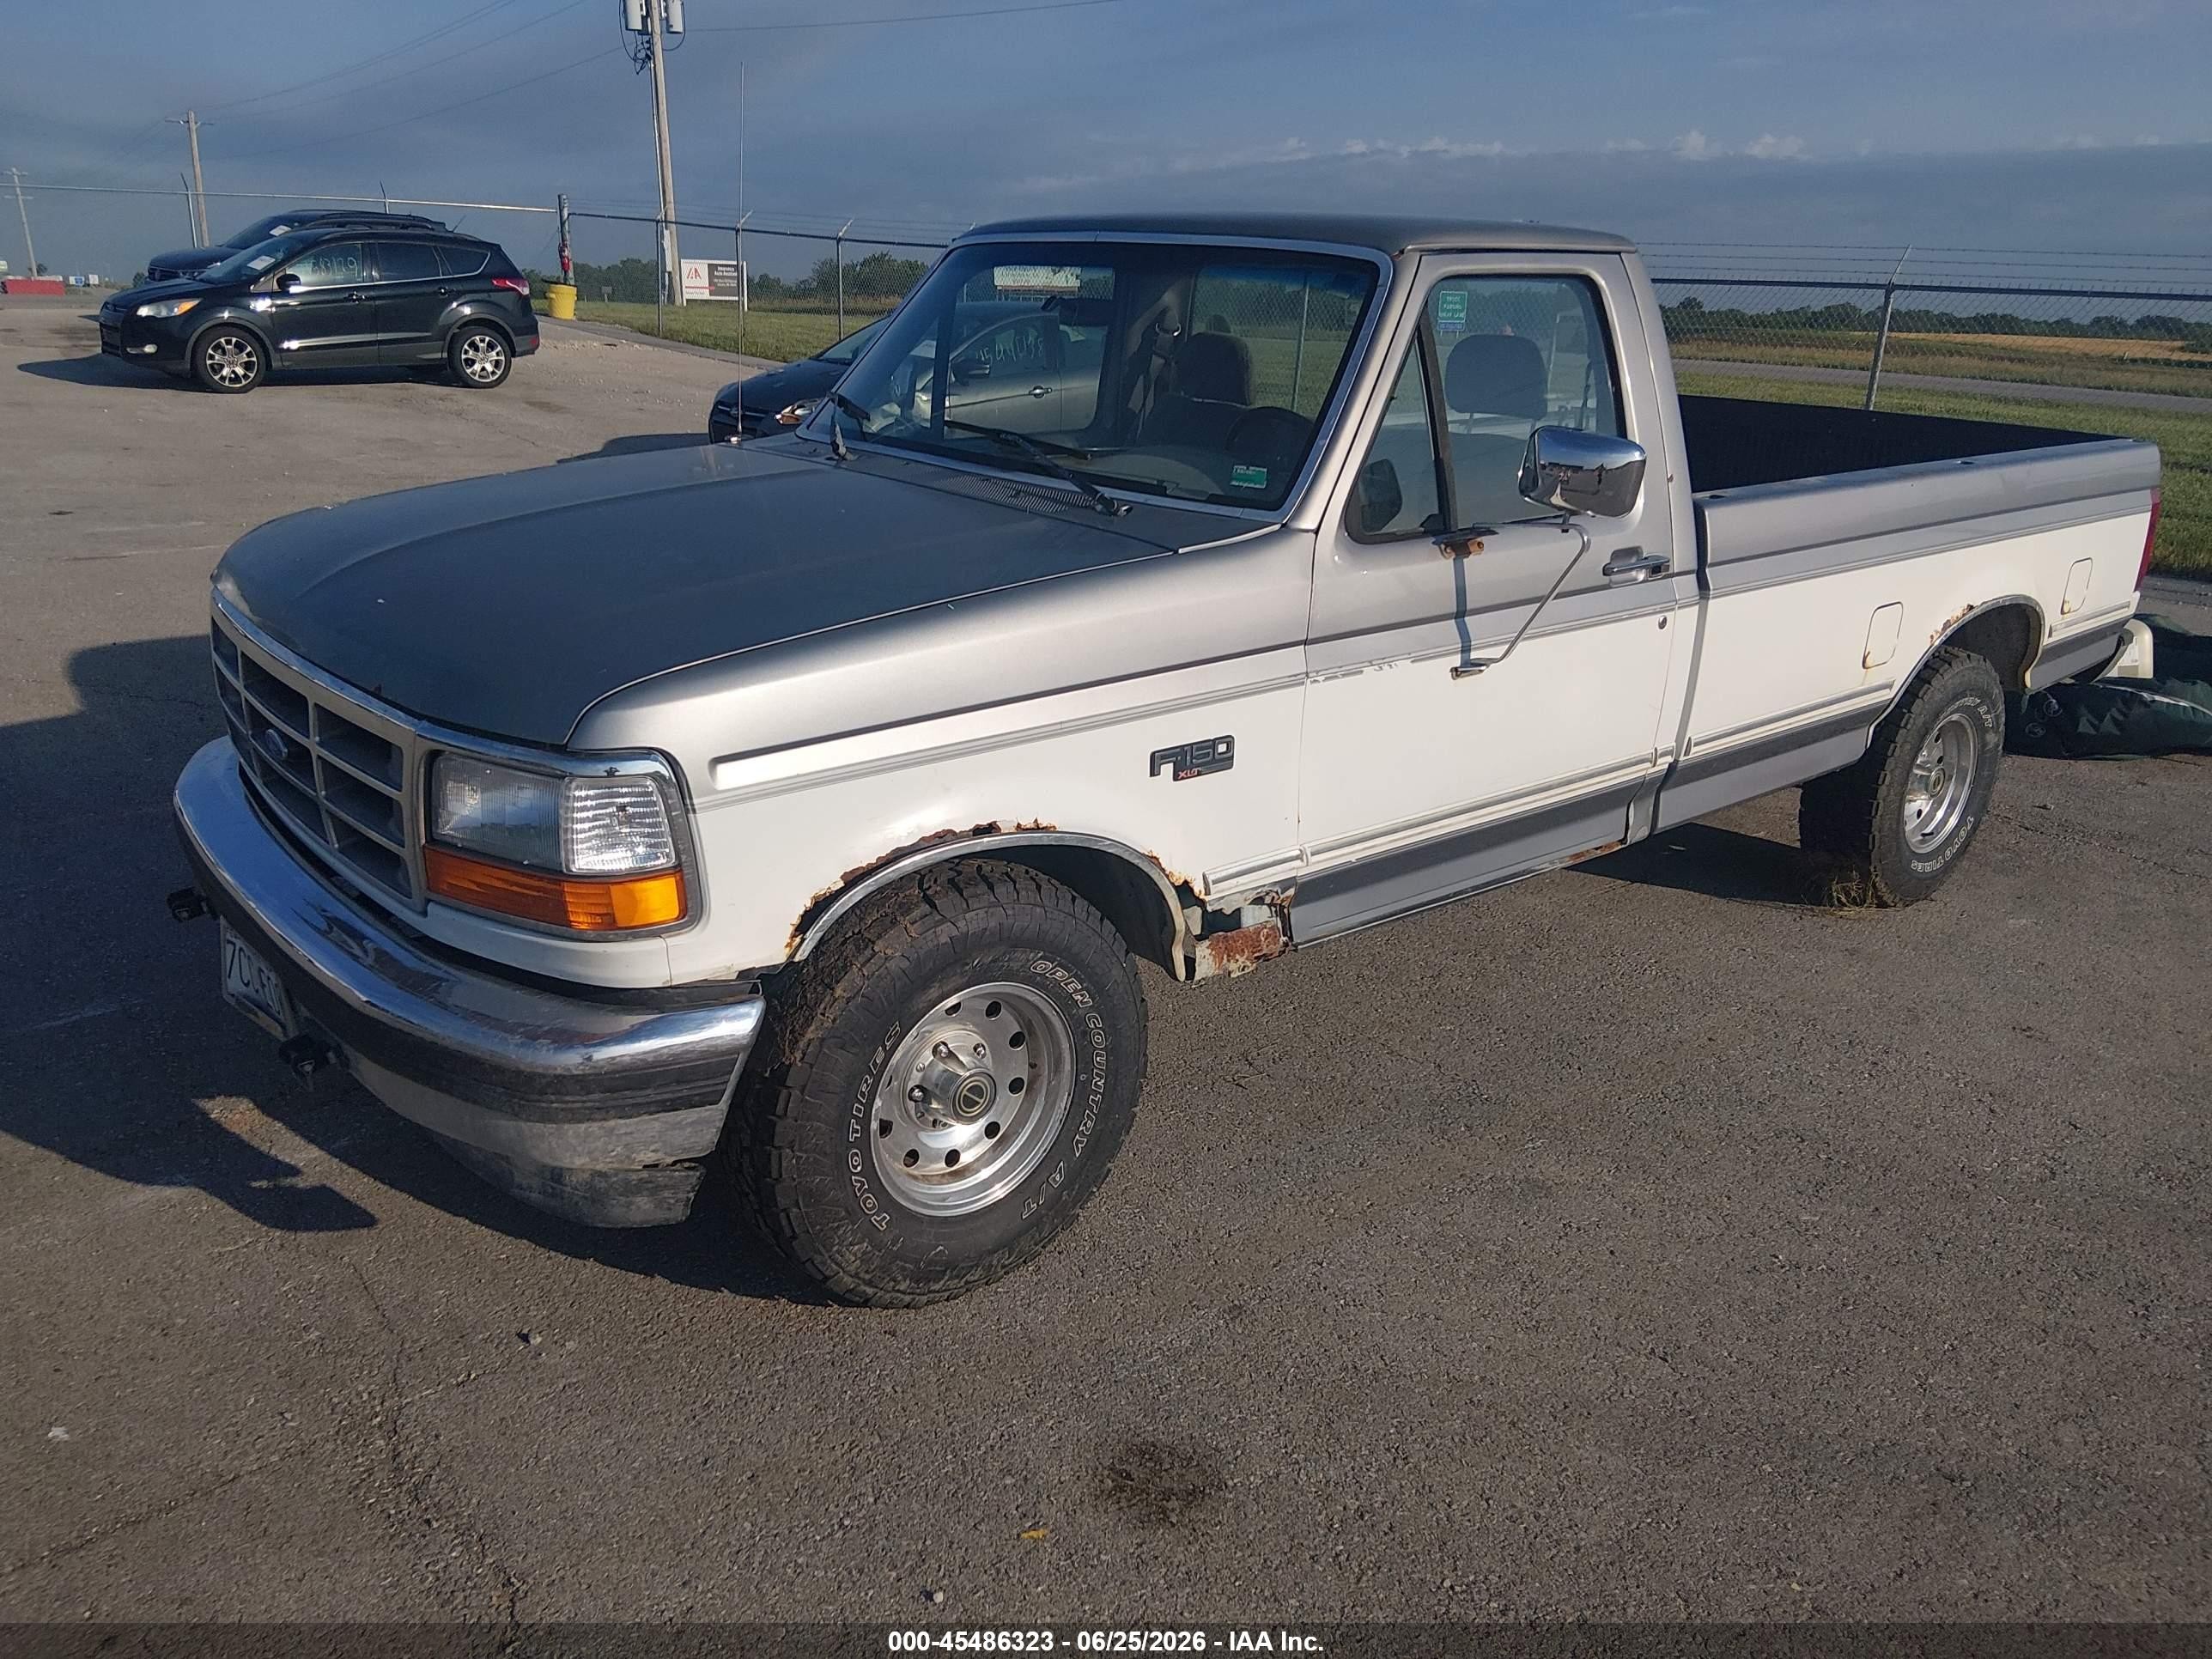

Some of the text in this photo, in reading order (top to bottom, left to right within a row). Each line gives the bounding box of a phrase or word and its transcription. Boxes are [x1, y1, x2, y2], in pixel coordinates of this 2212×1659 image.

[1911, 815, 1975, 872] TOYO TIRES
[848, 1020, 902, 1231] TOYO TIRES
[1022, 960, 1107, 1220] OPEN COUNTRY A/T
